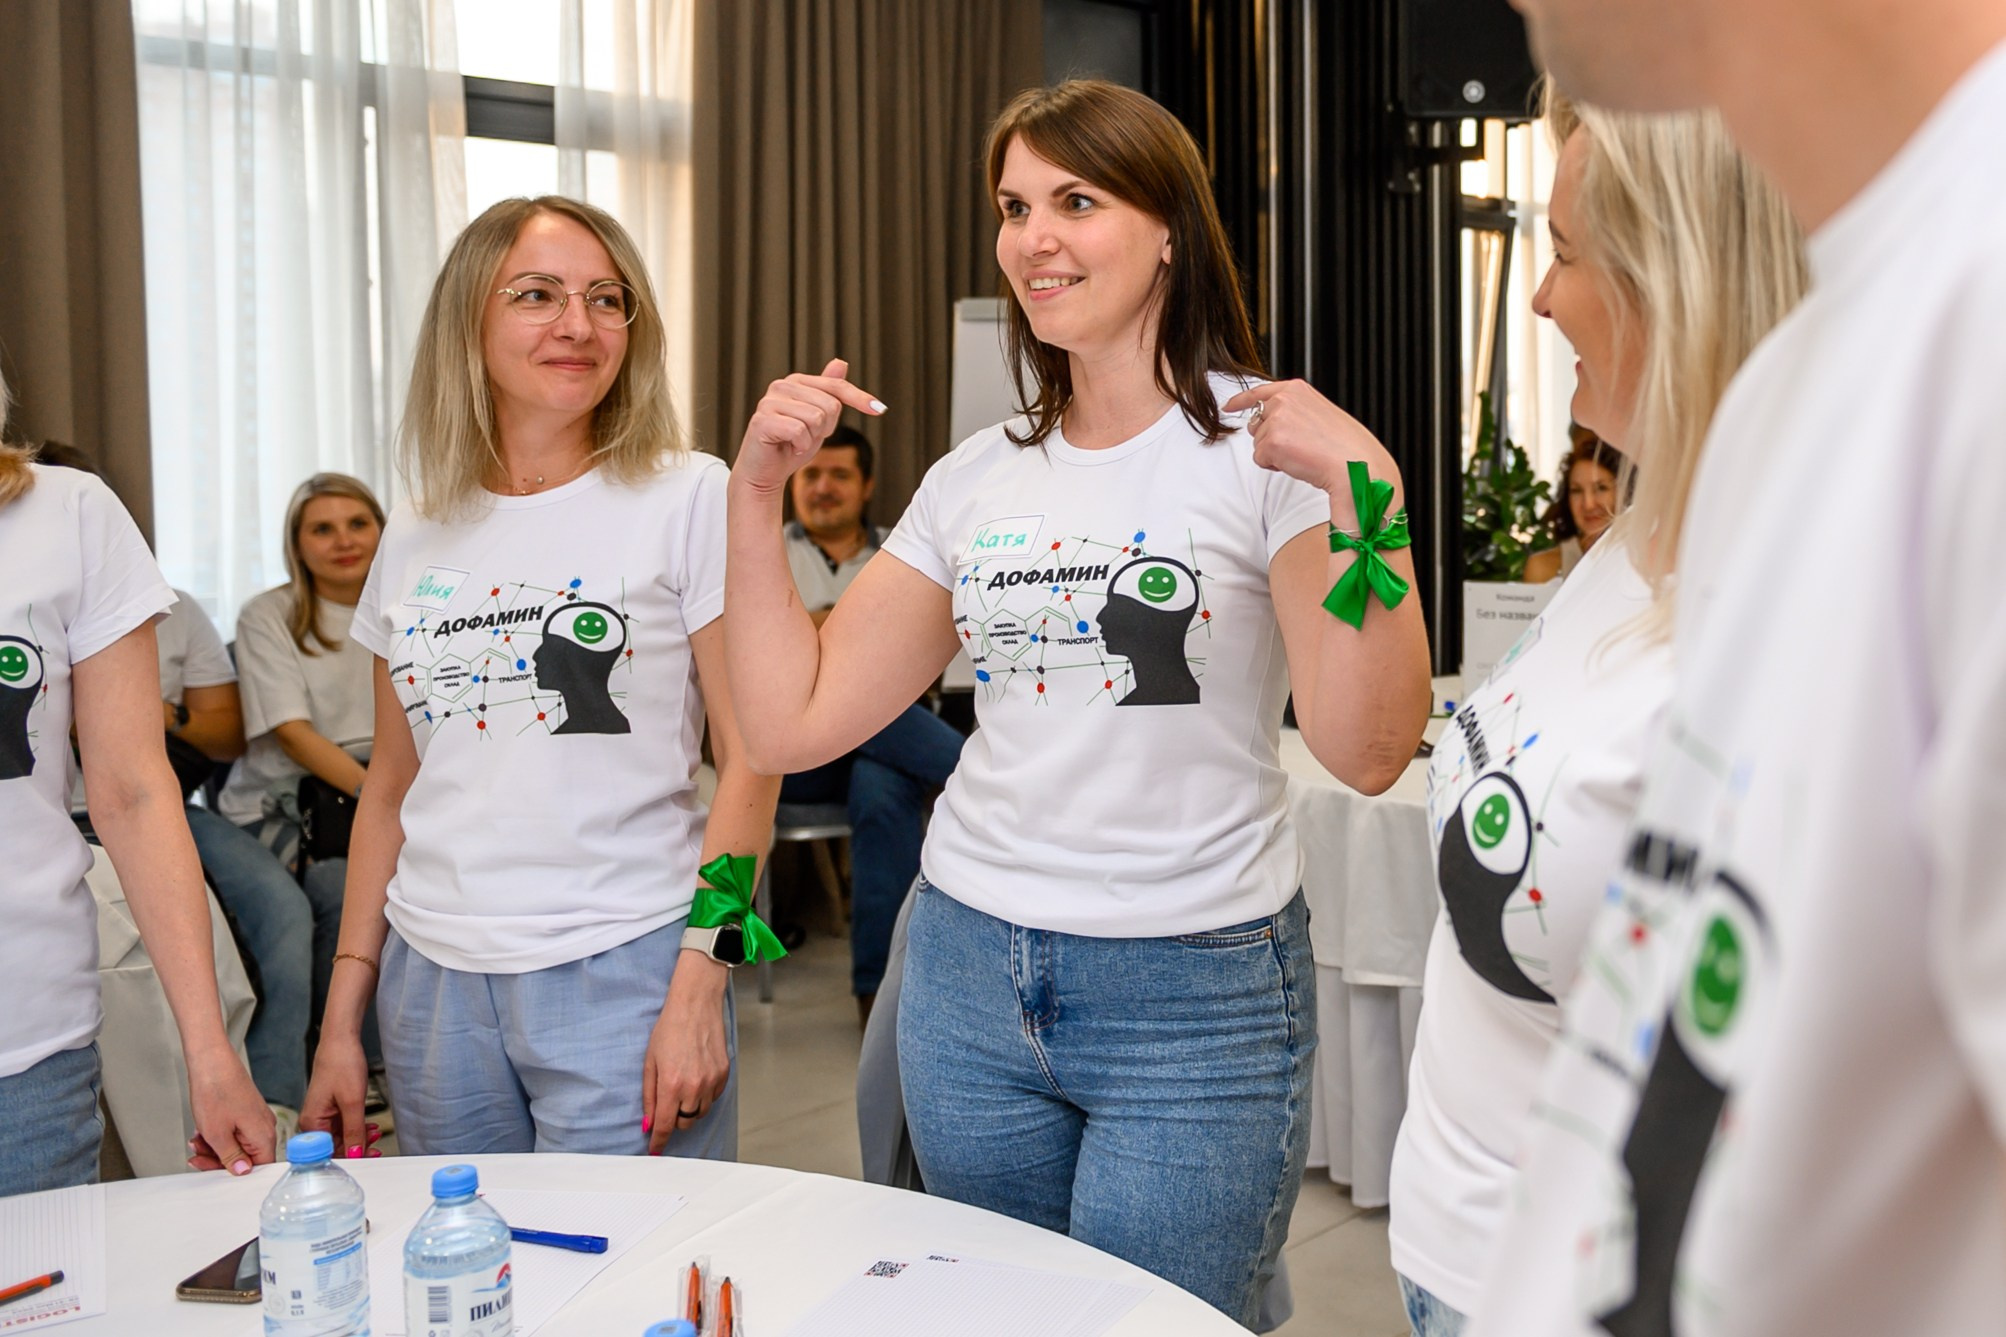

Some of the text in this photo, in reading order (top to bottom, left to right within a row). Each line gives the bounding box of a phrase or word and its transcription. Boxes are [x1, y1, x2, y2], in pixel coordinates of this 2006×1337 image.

[971, 528, 1027, 552] Катя
[987, 564, 1110, 591] ДОФАМИН
[413, 575, 455, 600] Юлия
[1496, 594, 1535, 602] Команда
[434, 605, 544, 638] ДОФАМИН
[1476, 609, 1496, 619] Без
[1057, 636, 1099, 647] ТРАНСПОРТ
[498, 673, 533, 684] ТРАНСПОРТ
